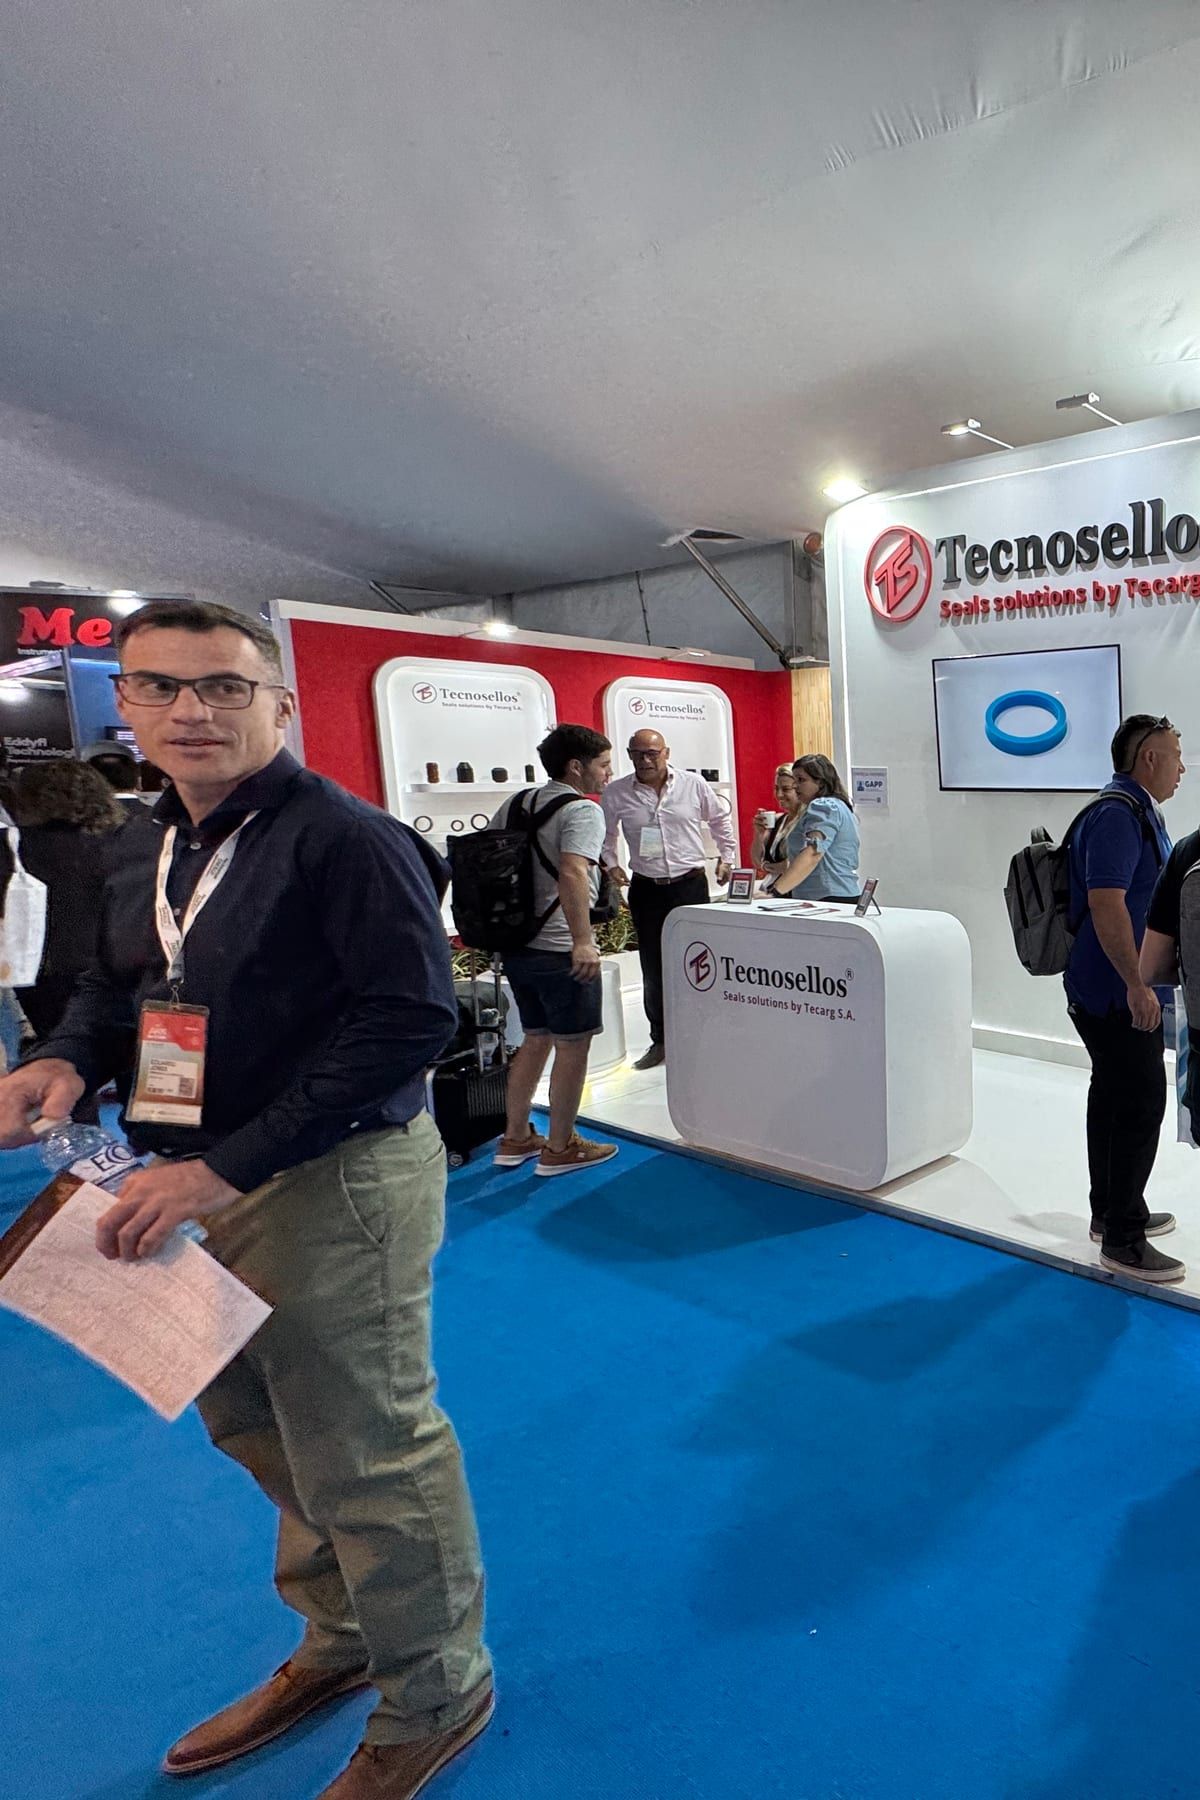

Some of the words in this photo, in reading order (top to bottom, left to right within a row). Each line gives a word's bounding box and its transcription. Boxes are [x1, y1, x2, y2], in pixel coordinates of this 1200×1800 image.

[940, 594, 991, 619] Seals
[993, 585, 1088, 613] solutions
[1092, 581, 1121, 607] by
[864, 780, 883, 788] GAPP
[723, 990, 746, 1003] Seals
[747, 995, 788, 1010] solutions
[790, 1000, 802, 1014] by
[804, 1003, 836, 1020] Tecarg
[837, 1008, 856, 1021] S.A.
